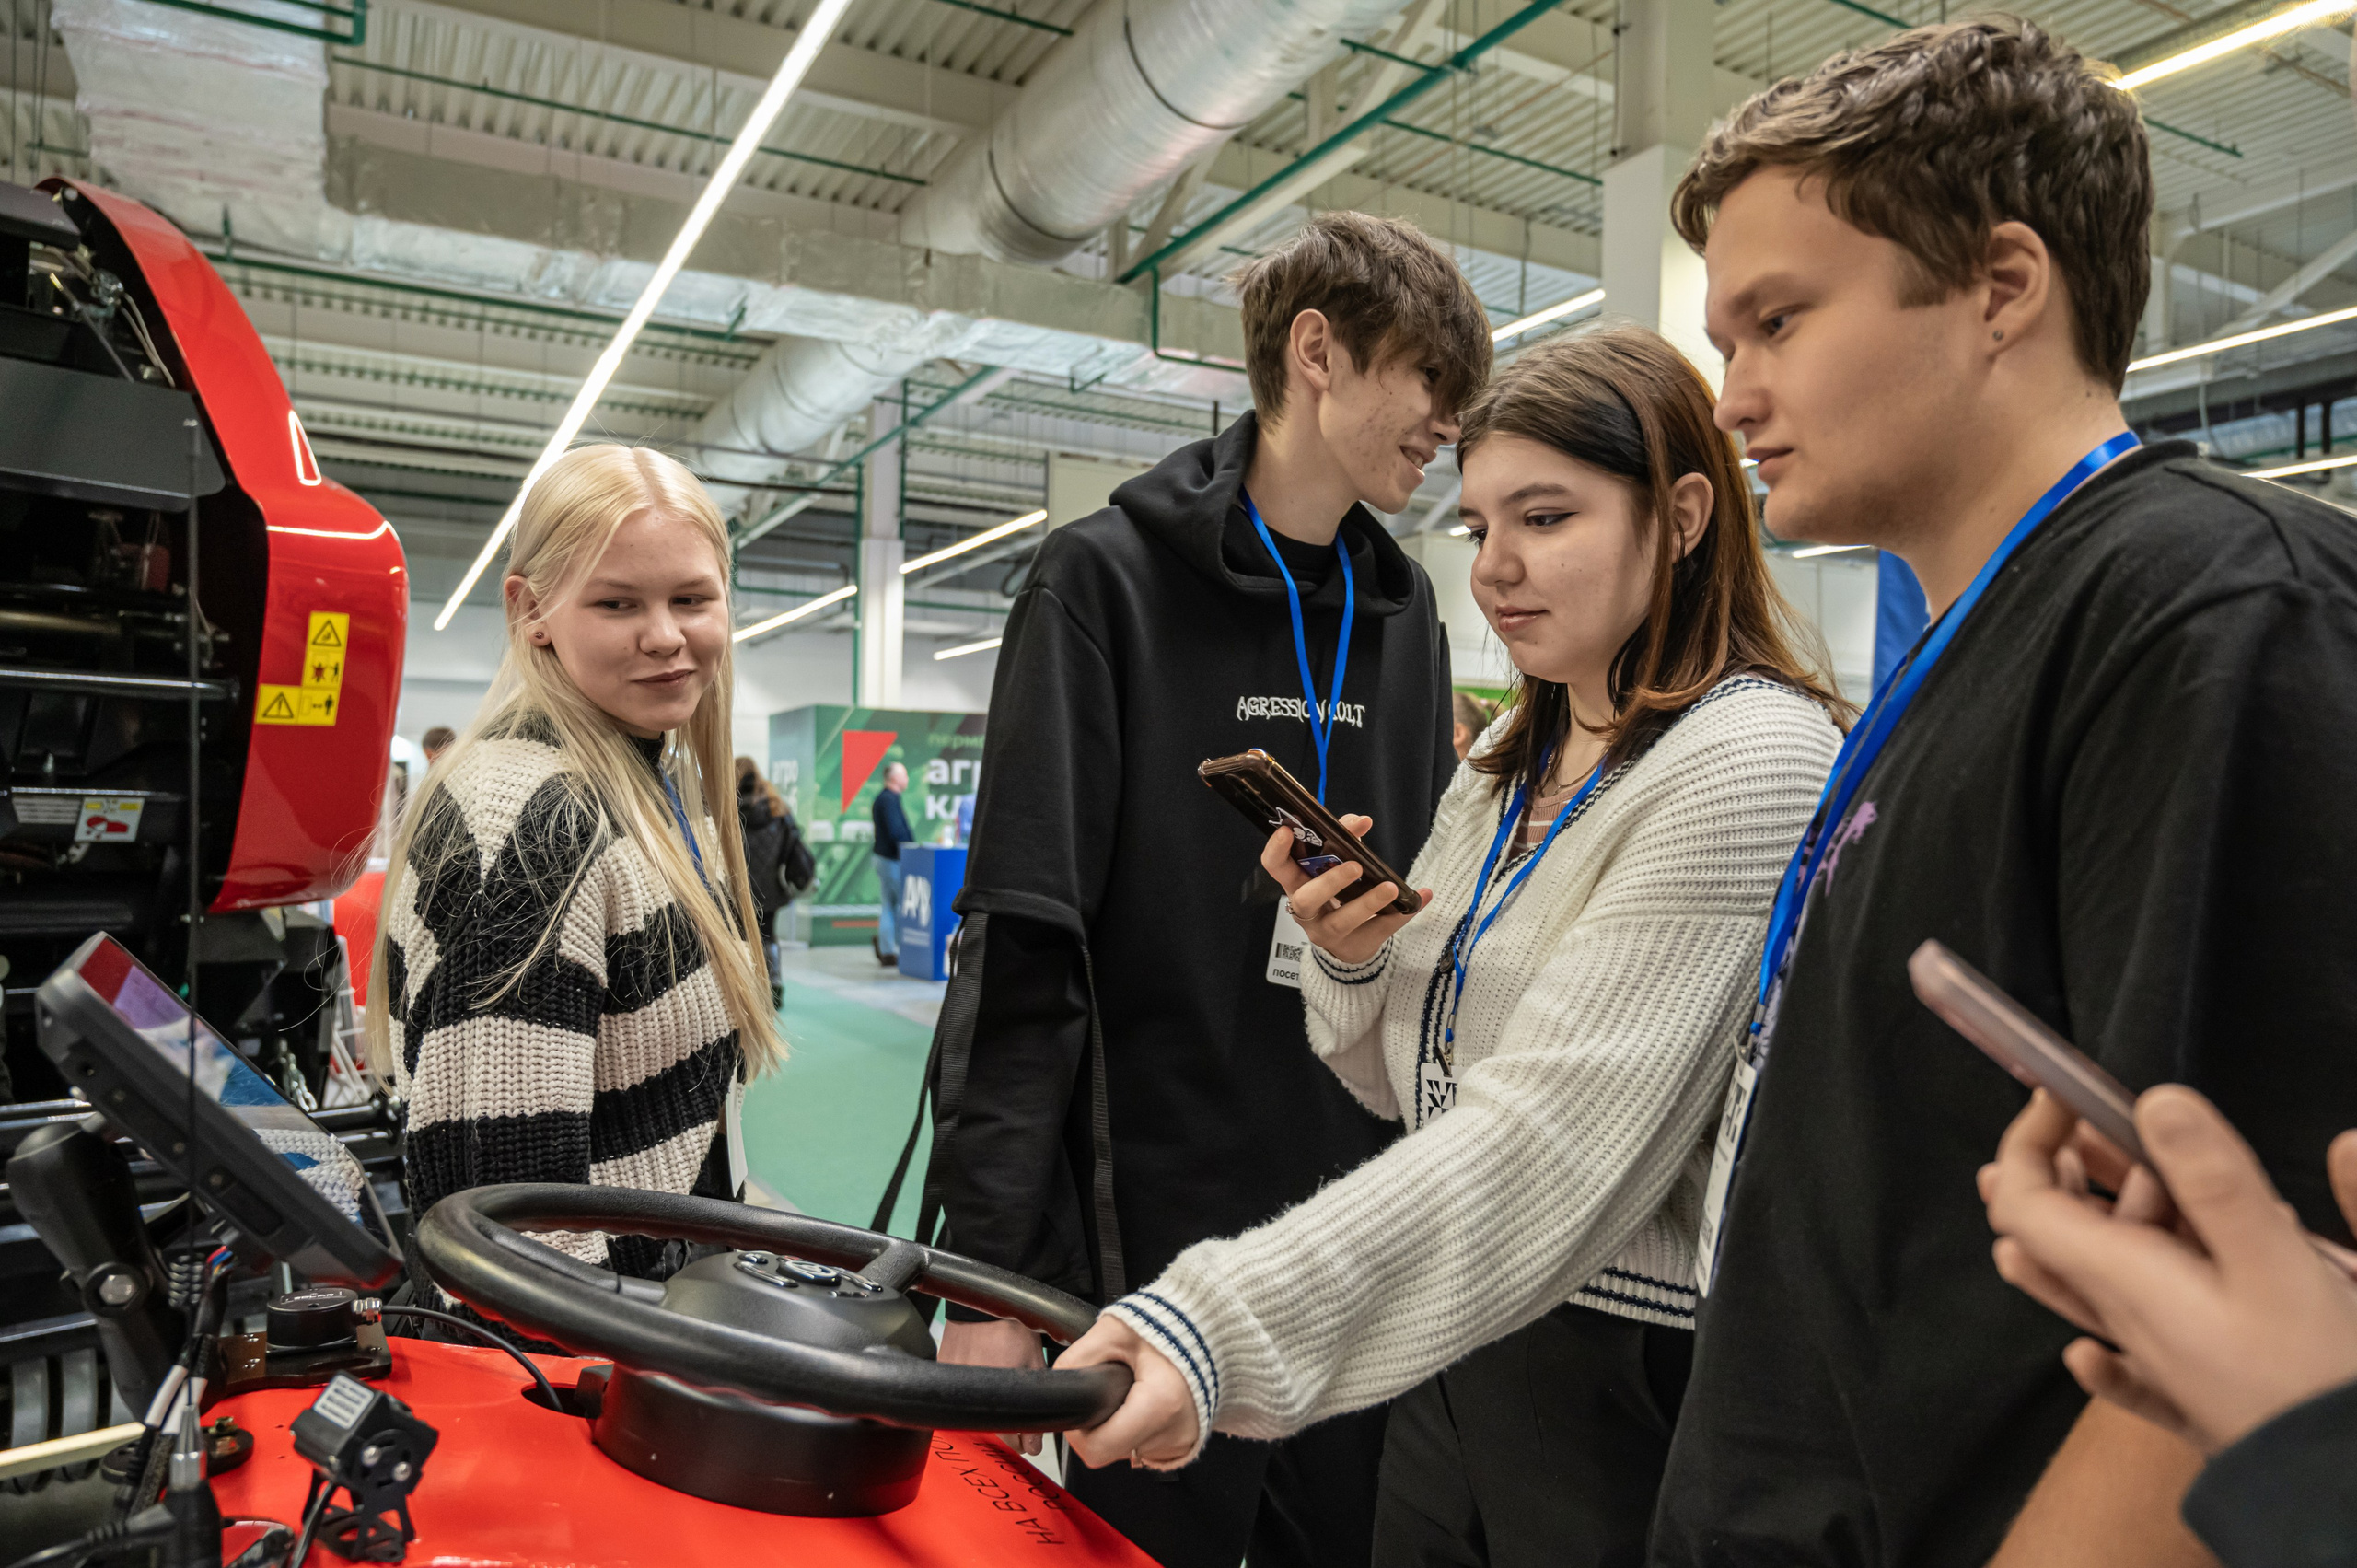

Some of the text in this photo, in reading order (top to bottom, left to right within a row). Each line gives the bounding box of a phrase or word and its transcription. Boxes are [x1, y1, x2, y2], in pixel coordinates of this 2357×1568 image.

[930, 1435, 1065, 1545] НА ВСЕХ ПО
